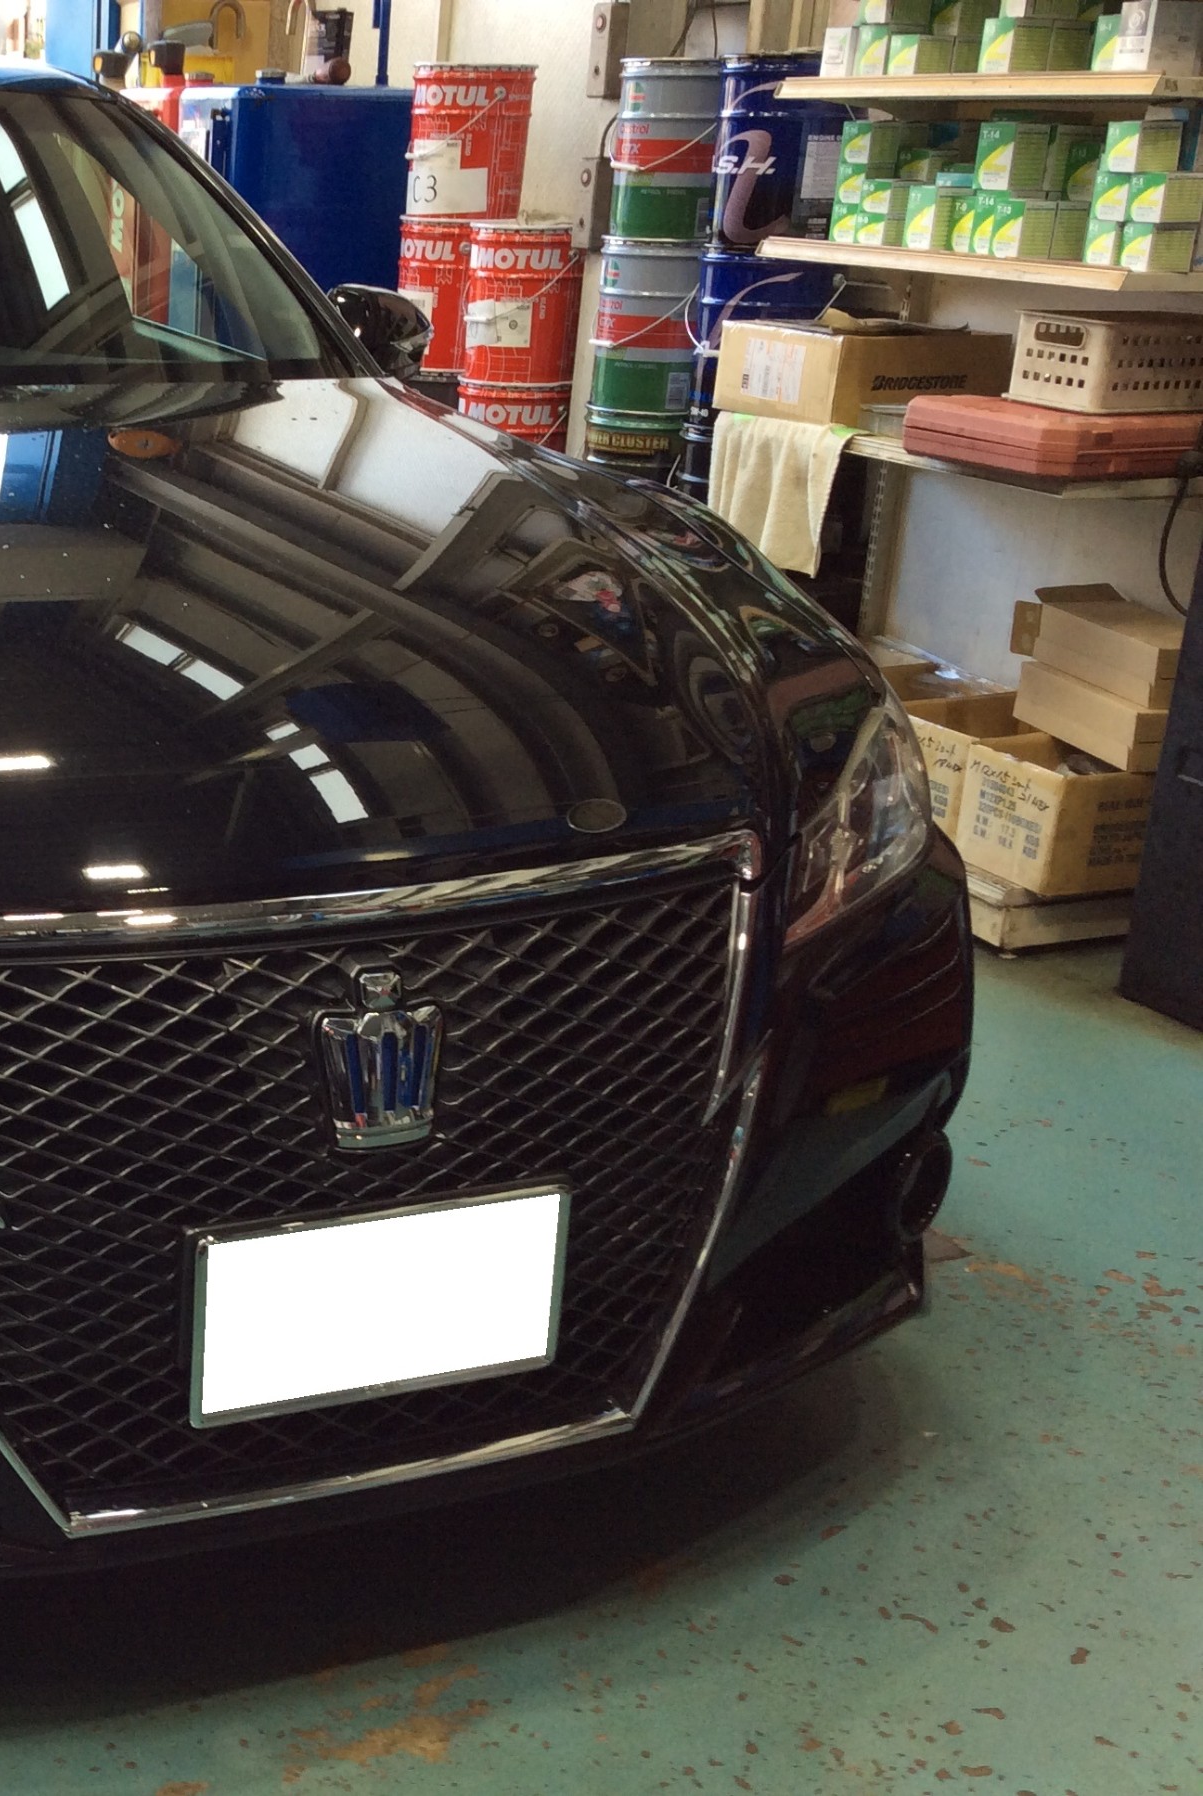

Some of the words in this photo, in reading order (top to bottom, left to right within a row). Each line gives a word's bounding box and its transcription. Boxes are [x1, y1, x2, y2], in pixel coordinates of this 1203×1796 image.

[413, 84, 489, 106] MOTUL
[476, 247, 564, 269] MOTUL
[871, 375, 968, 391] BRIDGESTONE
[467, 401, 555, 426] MOTUL
